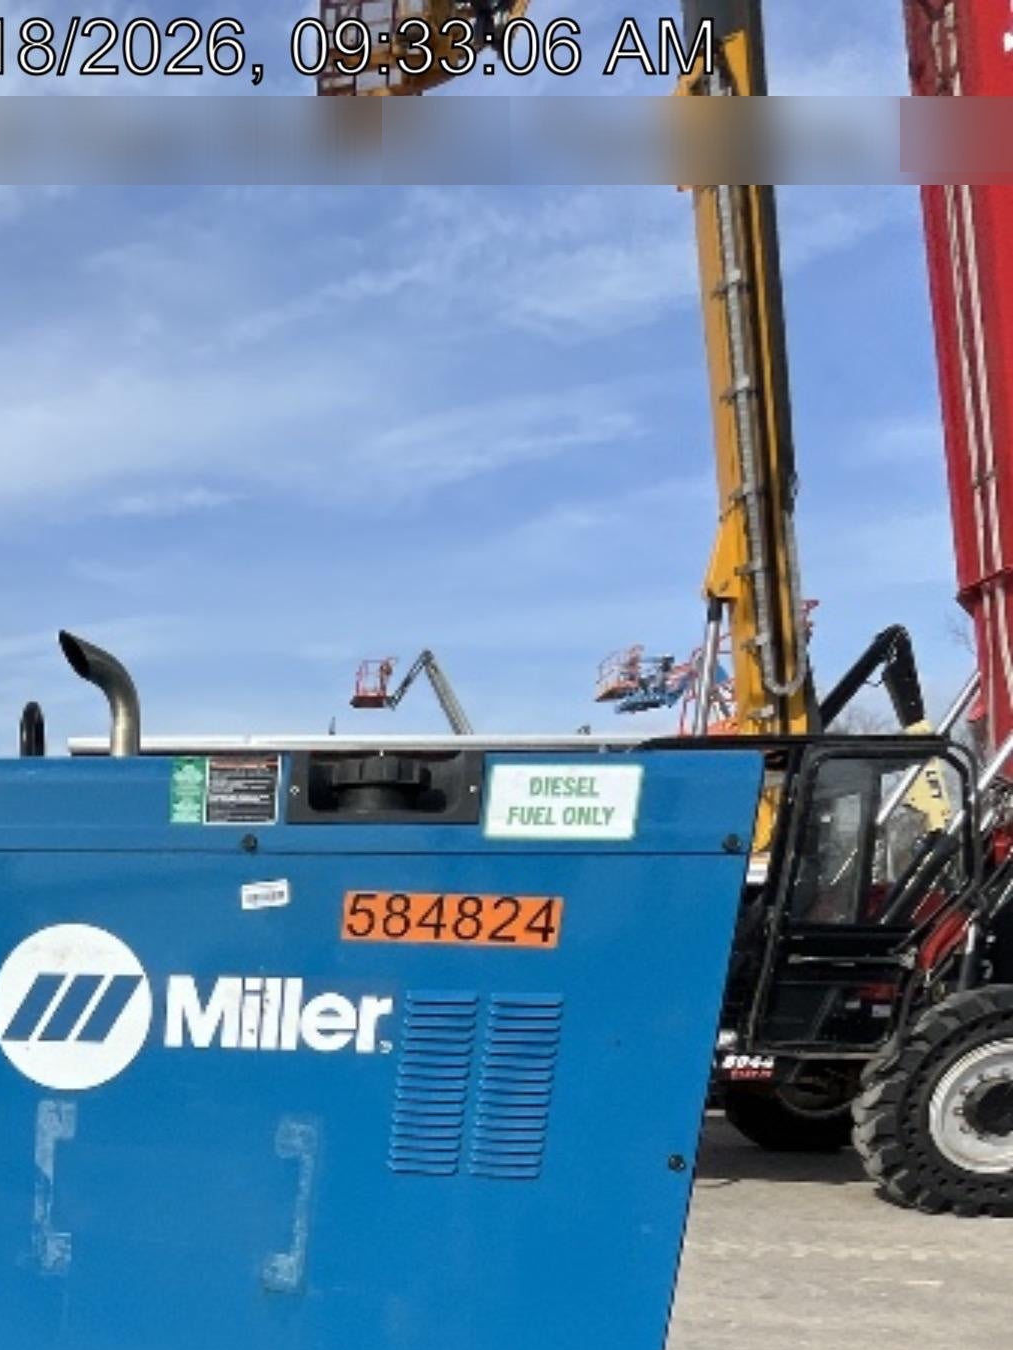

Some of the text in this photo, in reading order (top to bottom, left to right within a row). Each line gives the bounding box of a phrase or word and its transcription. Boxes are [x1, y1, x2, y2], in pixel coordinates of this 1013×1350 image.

[529, 776, 600, 797] DIESEL
[506, 806, 616, 825] FUEL ONLY
[346, 893, 556, 943] 584824
[163, 974, 393, 1053] Miller
